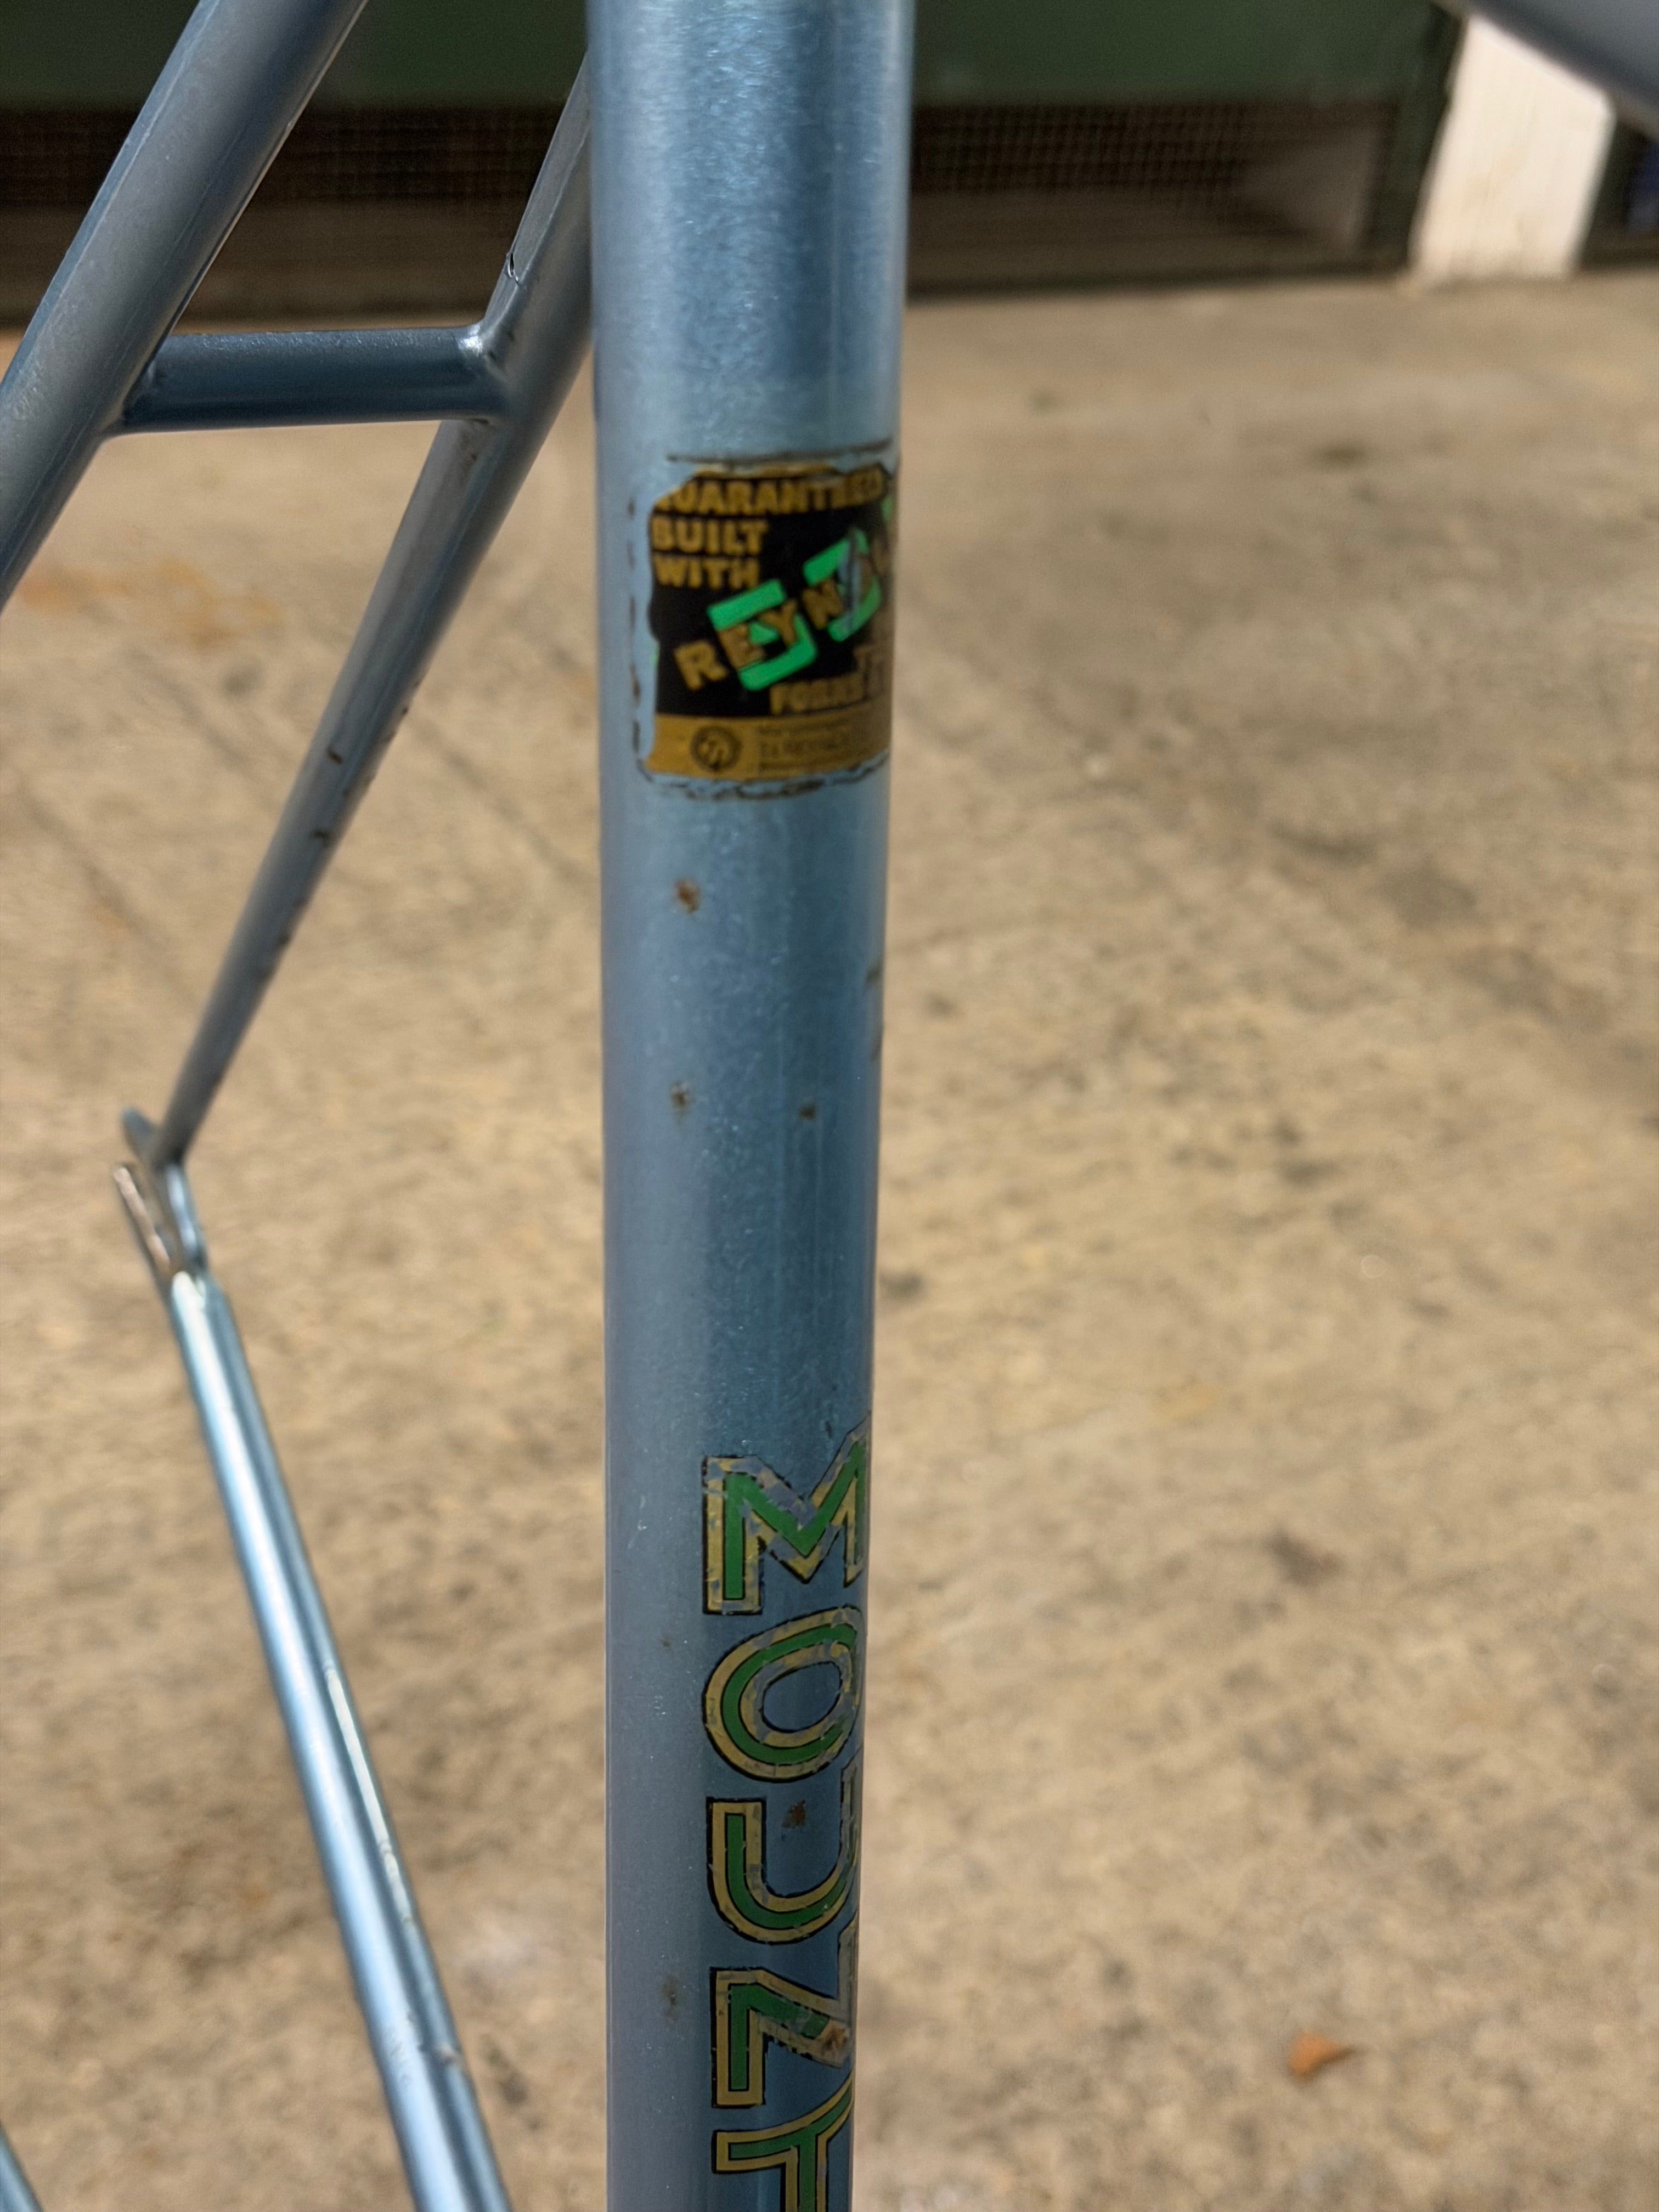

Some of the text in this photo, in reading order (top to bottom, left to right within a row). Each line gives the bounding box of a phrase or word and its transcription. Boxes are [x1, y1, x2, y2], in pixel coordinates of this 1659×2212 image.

[652, 518, 768, 554] BUILT
[654, 556, 761, 589] WITH
[702, 1418, 870, 2212] MOUNT
